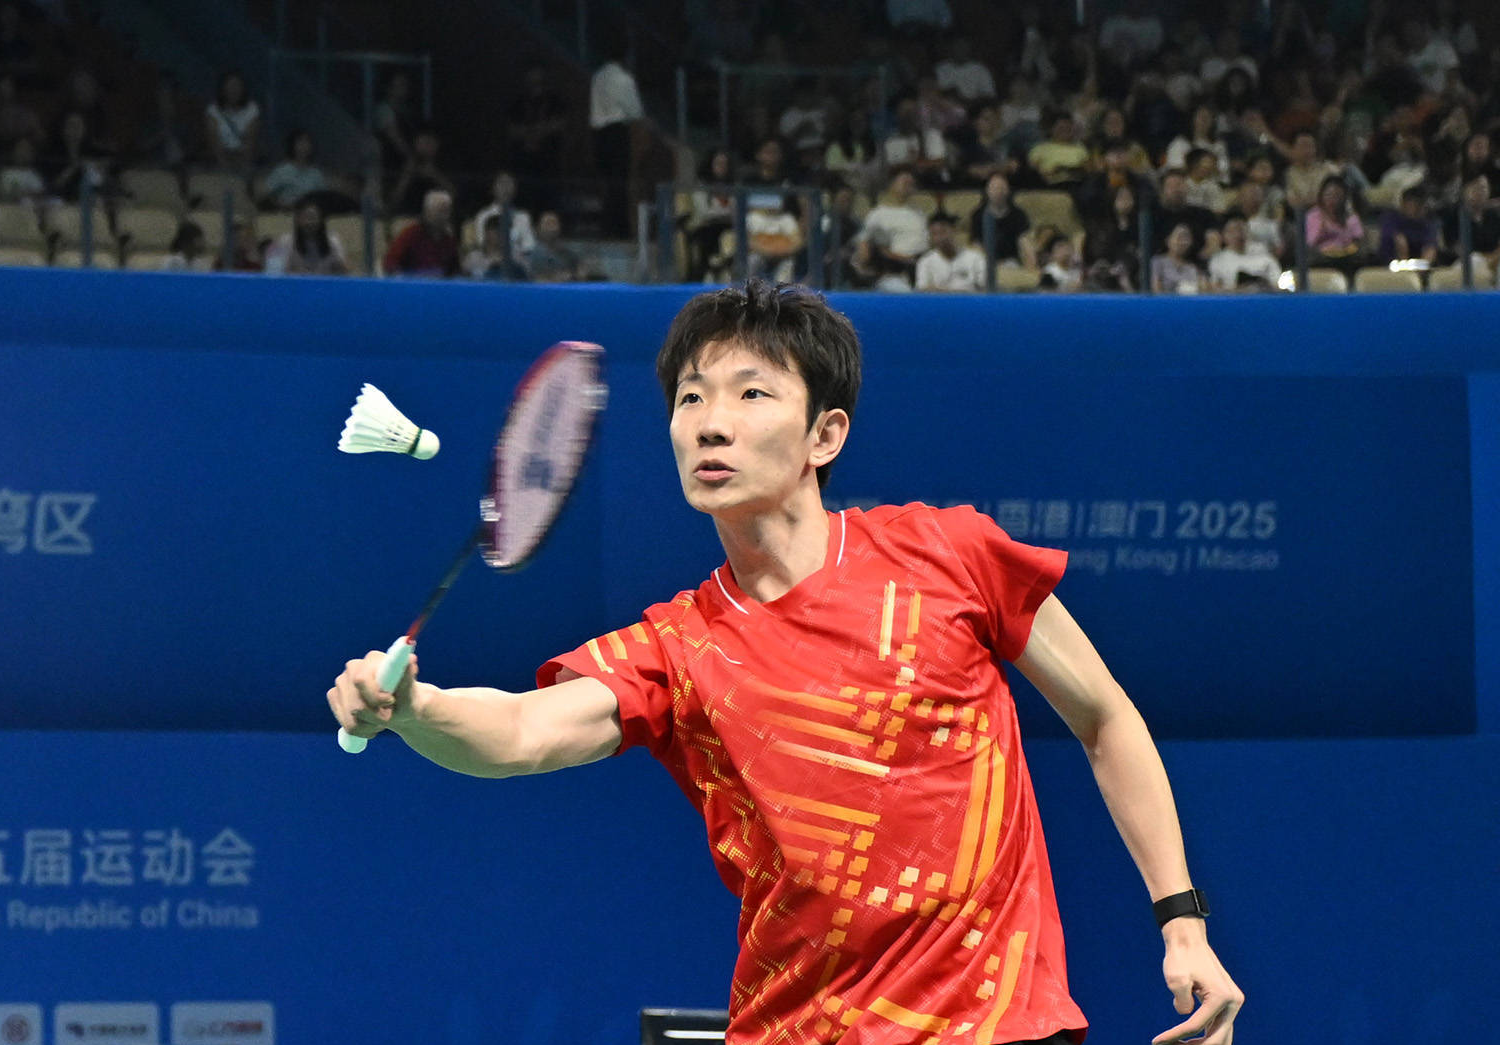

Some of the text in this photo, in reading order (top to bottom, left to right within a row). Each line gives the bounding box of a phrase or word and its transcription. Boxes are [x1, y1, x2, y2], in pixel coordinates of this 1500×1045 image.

[1175, 501, 1277, 539] 2025
[1067, 551, 1108, 575] ong
[1114, 548, 1178, 575] Kong
[1197, 549, 1280, 571] Macao
[7, 900, 133, 934] Republic
[140, 900, 169, 929] of
[177, 900, 260, 929] China
